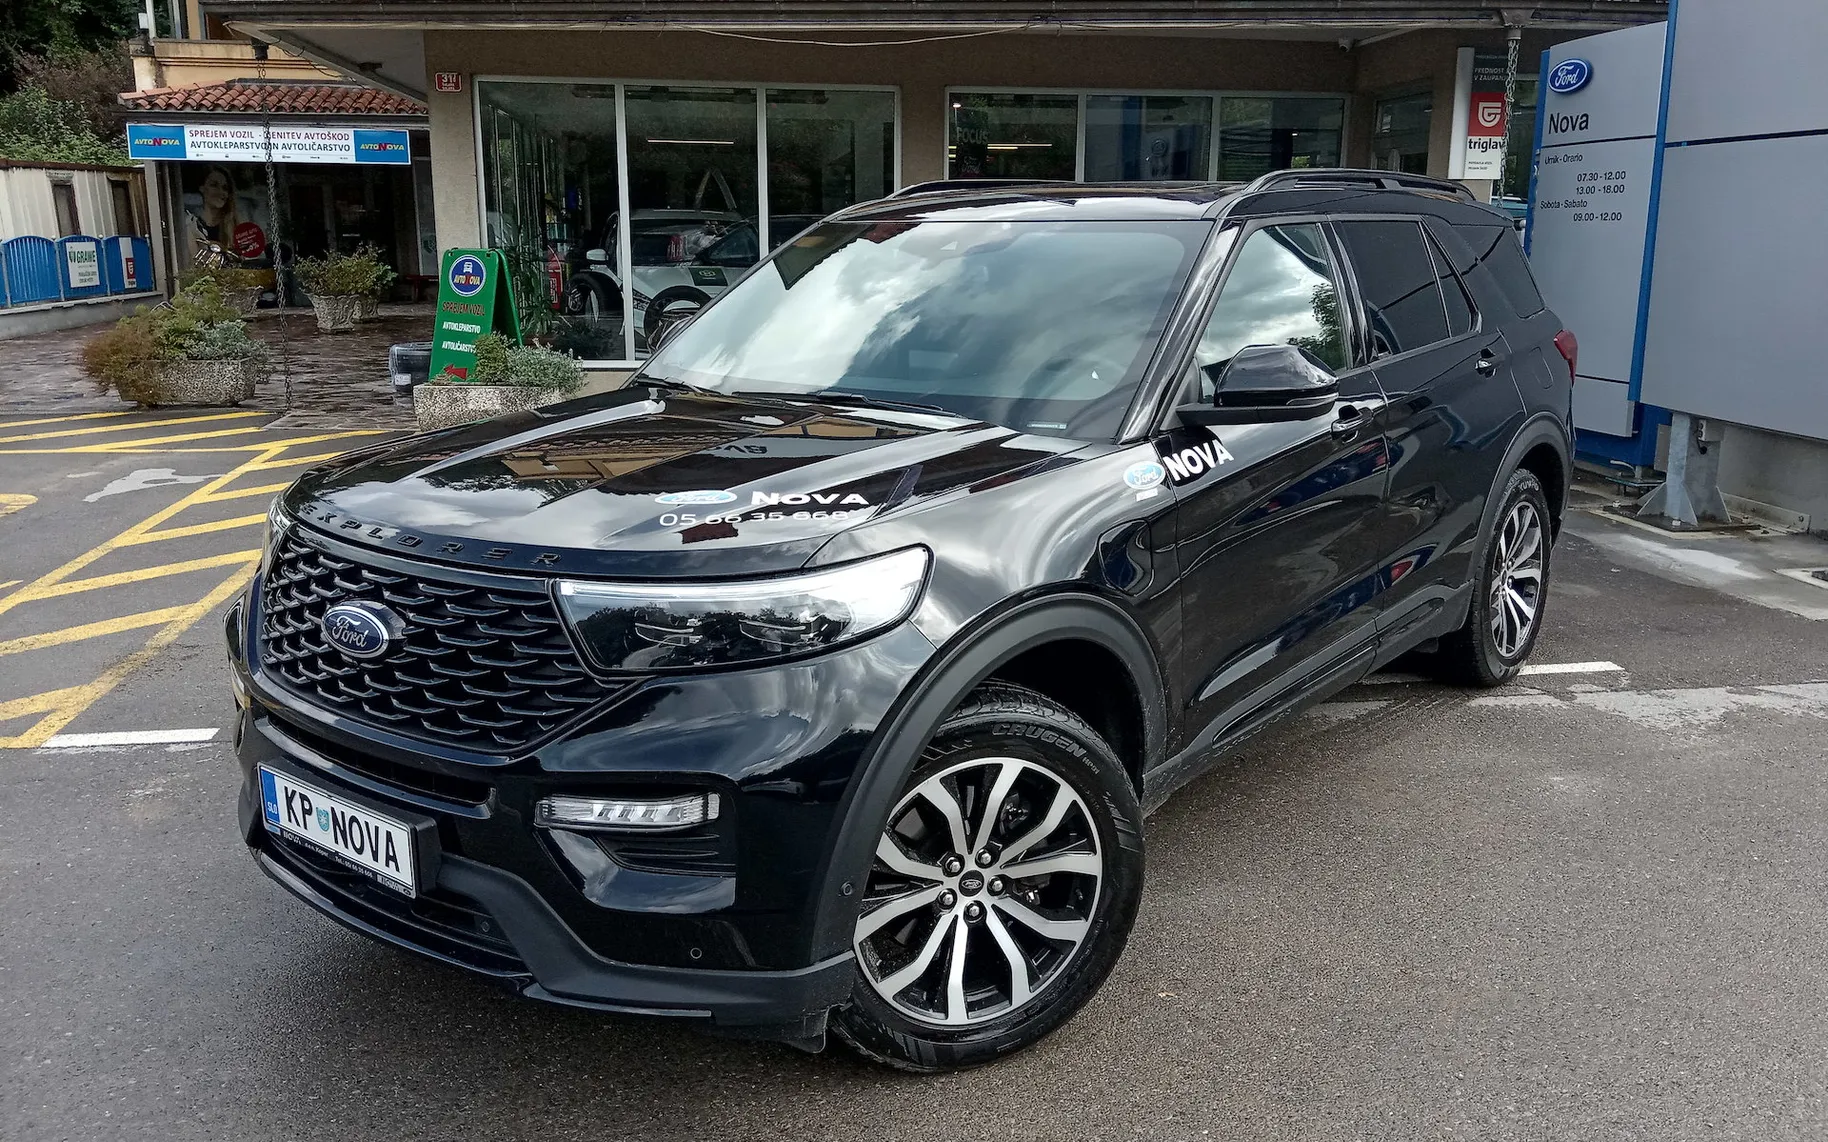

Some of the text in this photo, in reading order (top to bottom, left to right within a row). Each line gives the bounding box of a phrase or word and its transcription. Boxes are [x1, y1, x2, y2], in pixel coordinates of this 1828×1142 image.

[1554, 65, 1580, 86] Ford
[1548, 112, 1590, 134] Nova
[134, 138, 180, 146] AVTONOVA
[189, 130, 227, 138] SPREJEM
[230, 130, 254, 138] VOZIL
[304, 132, 350, 140] AVTOŠKOD
[956, 126, 989, 144] FOCUS
[281, 142, 350, 152] AVTOLIČARSTVO
[1468, 138, 1505, 152] triglav
[1577, 172, 1598, 182] 07.30
[1604, 171, 1626, 180] 12.00
[1576, 186, 1595, 194] 13.00
[1603, 185, 1625, 194] 18.00
[1540, 200, 1560, 209] Sobota
[1564, 199, 1588, 208] Sabato
[1600, 212, 1622, 221] 12.00
[77, 250, 96, 264] GRAWE
[442, 301, 485, 316] SPREJEM VOZIL
[442, 321, 480, 334] AVTOKLEPARSTVO
[1134, 439, 1234, 485] Ford NOVA
[750, 491, 869, 505] NOVA
[659, 513, 696, 526] 05
[705, 513, 742, 525] 66
[750, 511, 784, 522] 35
[300, 504, 562, 566] EXPLORER
[332, 615, 367, 647] Ford
[992, 722, 1087, 758] CRUGEN
[267, 801, 278, 814] SLO
[284, 786, 401, 873] KP NOVA
